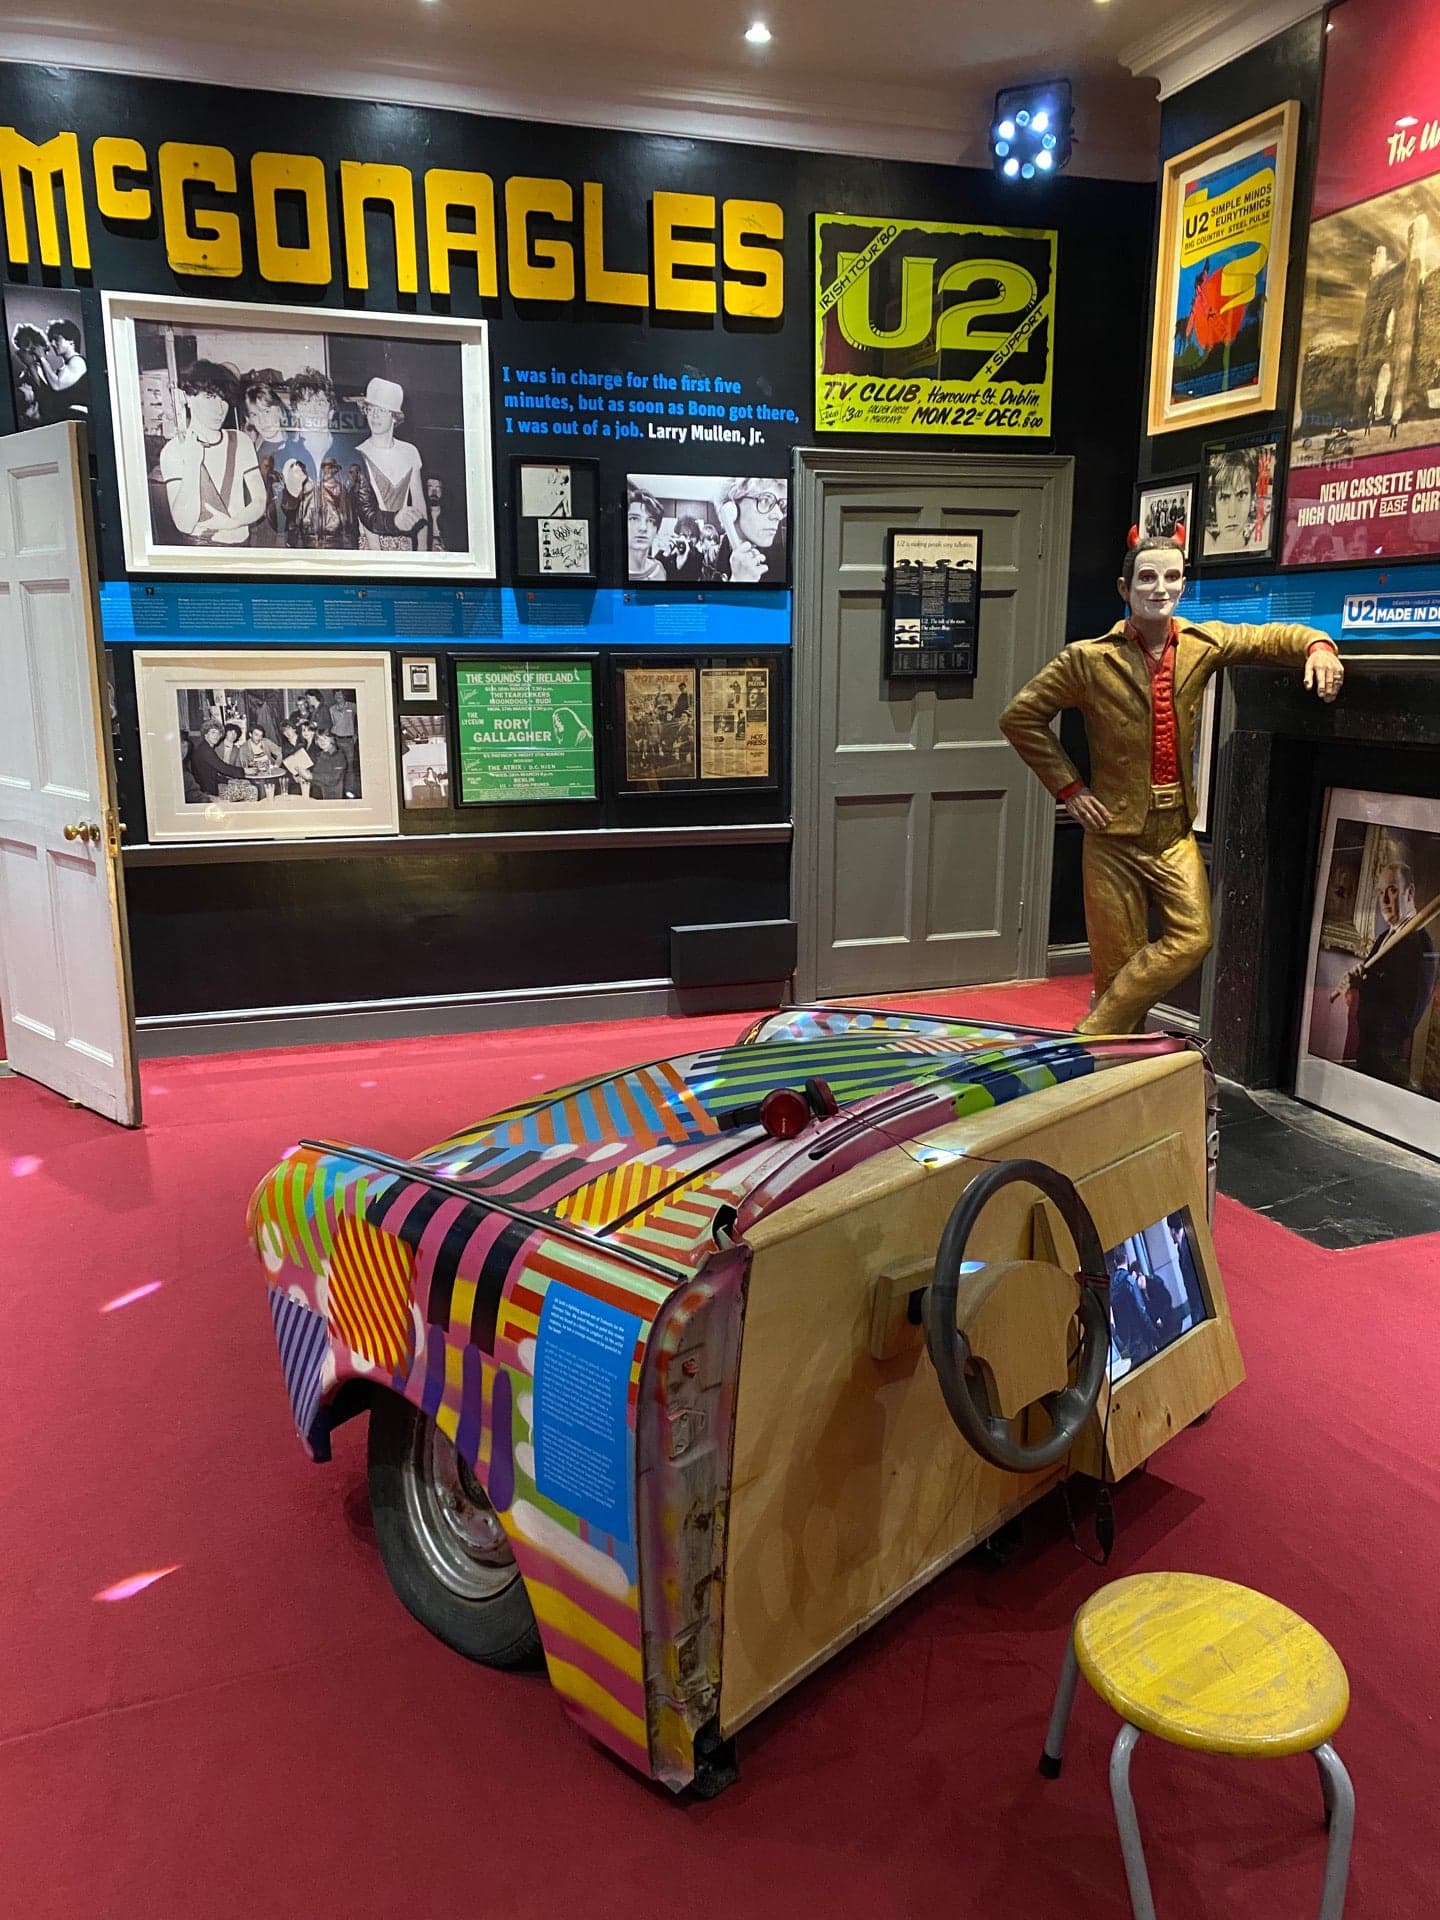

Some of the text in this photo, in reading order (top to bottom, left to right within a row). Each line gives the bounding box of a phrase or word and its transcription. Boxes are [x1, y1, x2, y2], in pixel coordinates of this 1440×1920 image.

[1387, 129, 1417, 167] The
[1211, 183, 1272, 217] SIMPLE MINDS
[1215, 196, 1271, 228] EURYTHMICS
[1186, 211, 1209, 239] U2
[1196, 229, 1224, 246] COUNTRY
[1228, 220, 1247, 233] STEEL
[1249, 210, 1270, 226] PULSE
[820, 274, 851, 310] IRISH
[837, 252, 1037, 352] U2
[992, 306, 1046, 363] SUPPORT
[502, 367, 741, 394] I was in charge for the first five
[860, 382, 921, 404] CLUB,
[927, 385, 981, 404] Harcourt
[504, 392, 800, 424] minutes, but as soon as Bono got there,
[984, 408, 1021, 427] DEC.
[505, 417, 644, 440] I was out of a job.
[648, 422, 765, 446] Larry Mullen, Jr.
[1319, 480, 1349, 503] NEW
[1349, 471, 1414, 499] CASSETTE
[1297, 506, 1326, 527] HIGH
[1327, 498, 1378, 526] QUALITY
[1381, 500, 1408, 514] BASF
[1348, 600, 1375, 622] U2
[1377, 607, 1412, 622] MADE
[1413, 607, 1428, 621] IN
[466, 672, 573, 684] THE SOUNDS OF IRELAND
[473, 731, 552, 743] GALLAGHER
[494, 719, 530, 730] RORY
